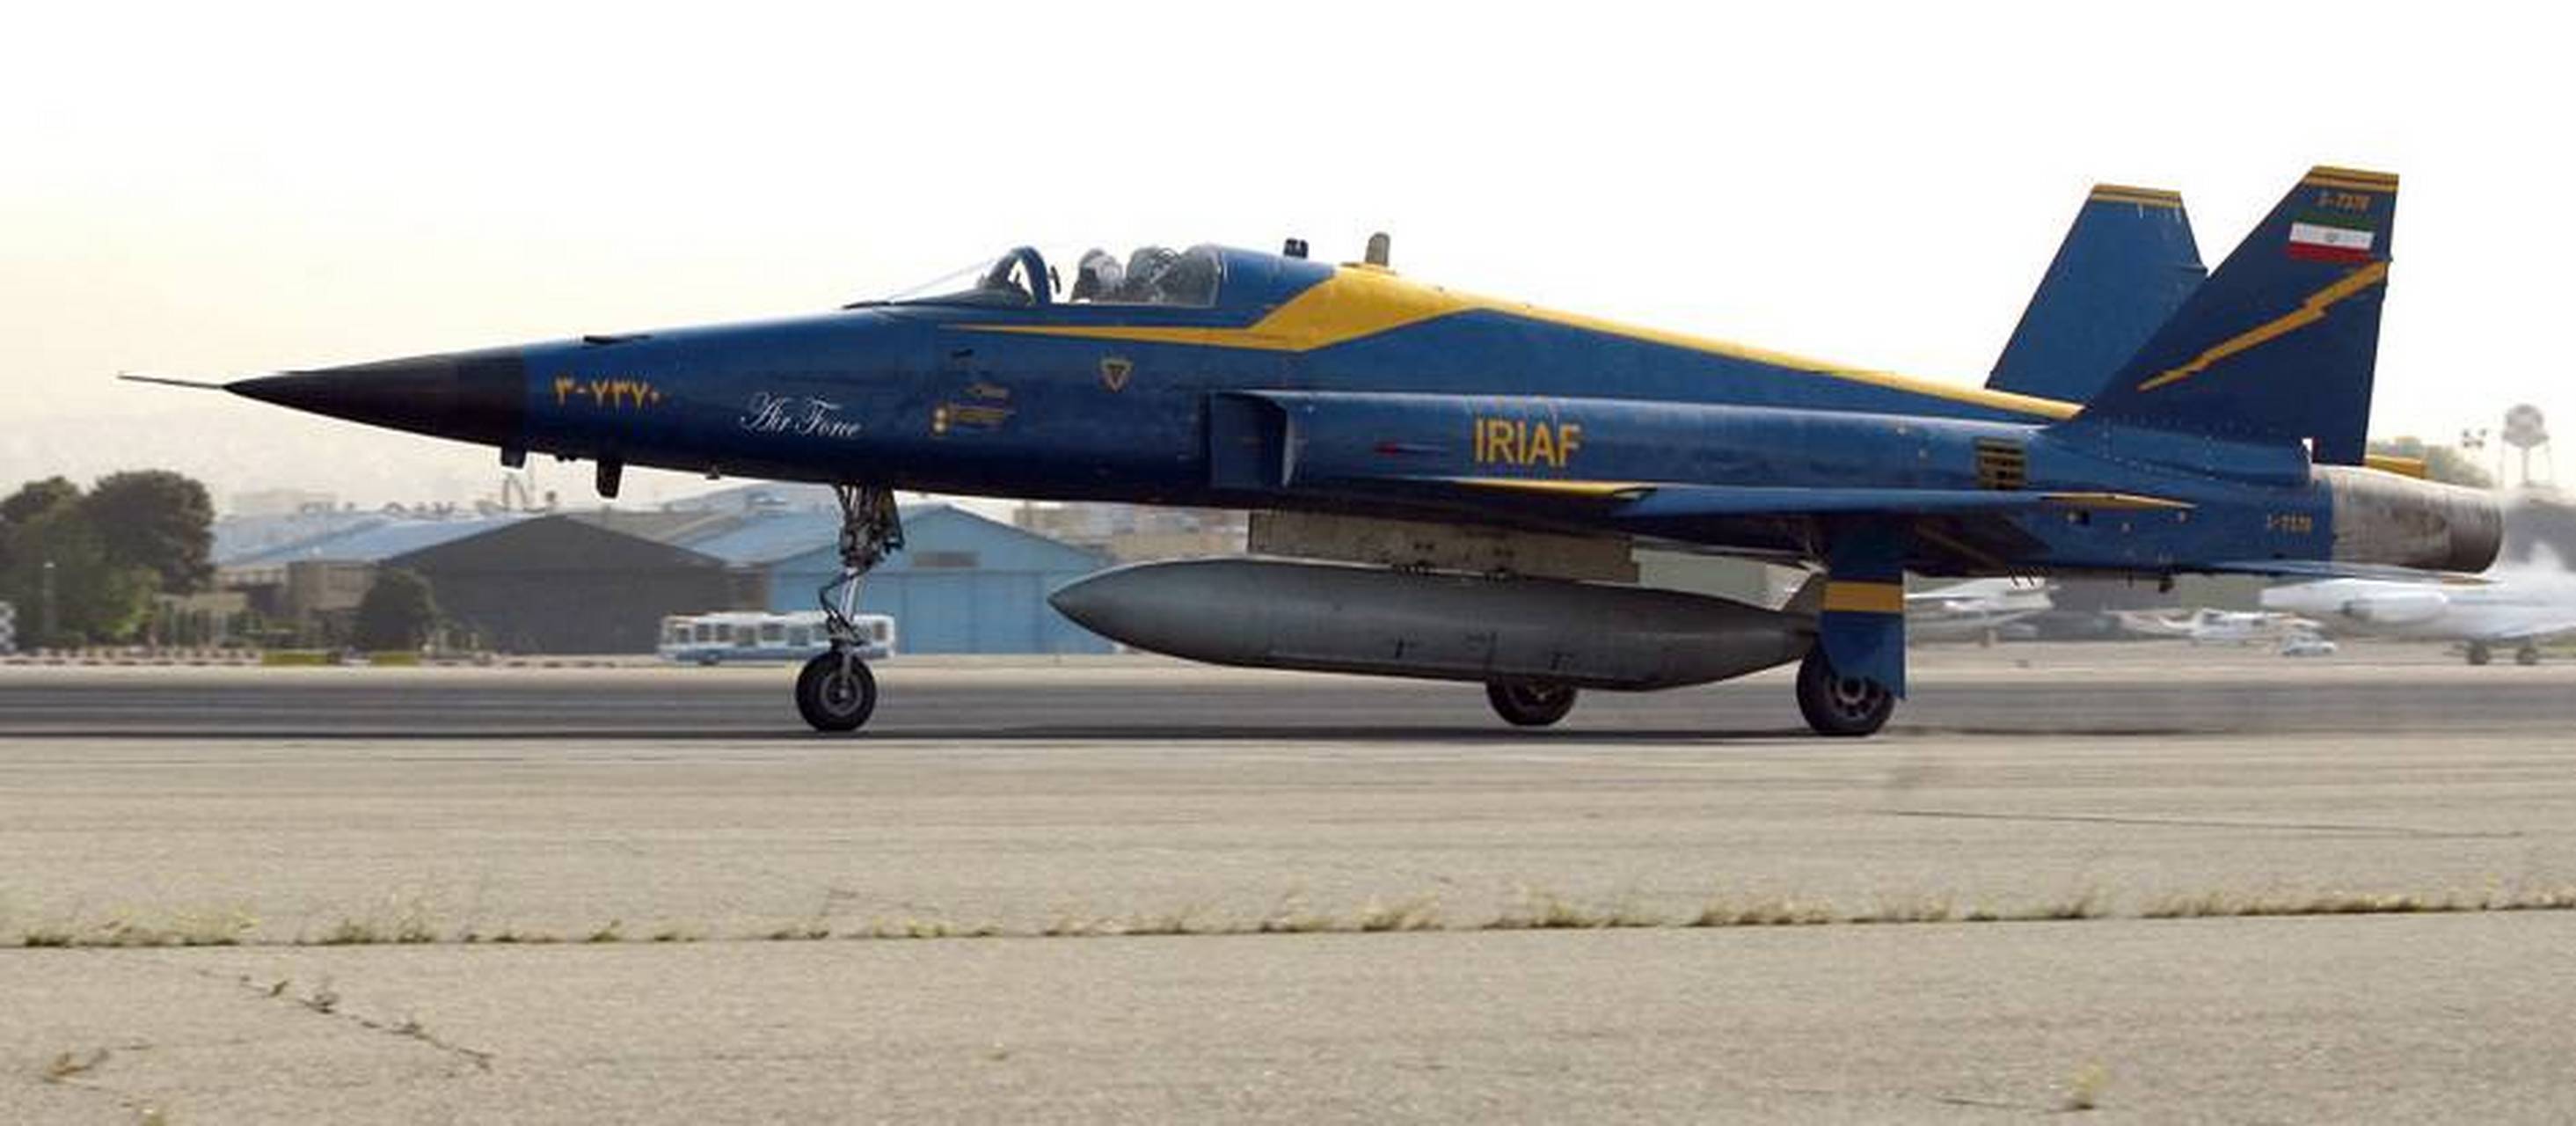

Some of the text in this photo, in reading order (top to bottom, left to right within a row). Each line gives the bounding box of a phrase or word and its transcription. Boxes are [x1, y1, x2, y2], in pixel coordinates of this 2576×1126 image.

[741, 391, 862, 436] Air Force
[1475, 418, 1581, 467] IRIAF
